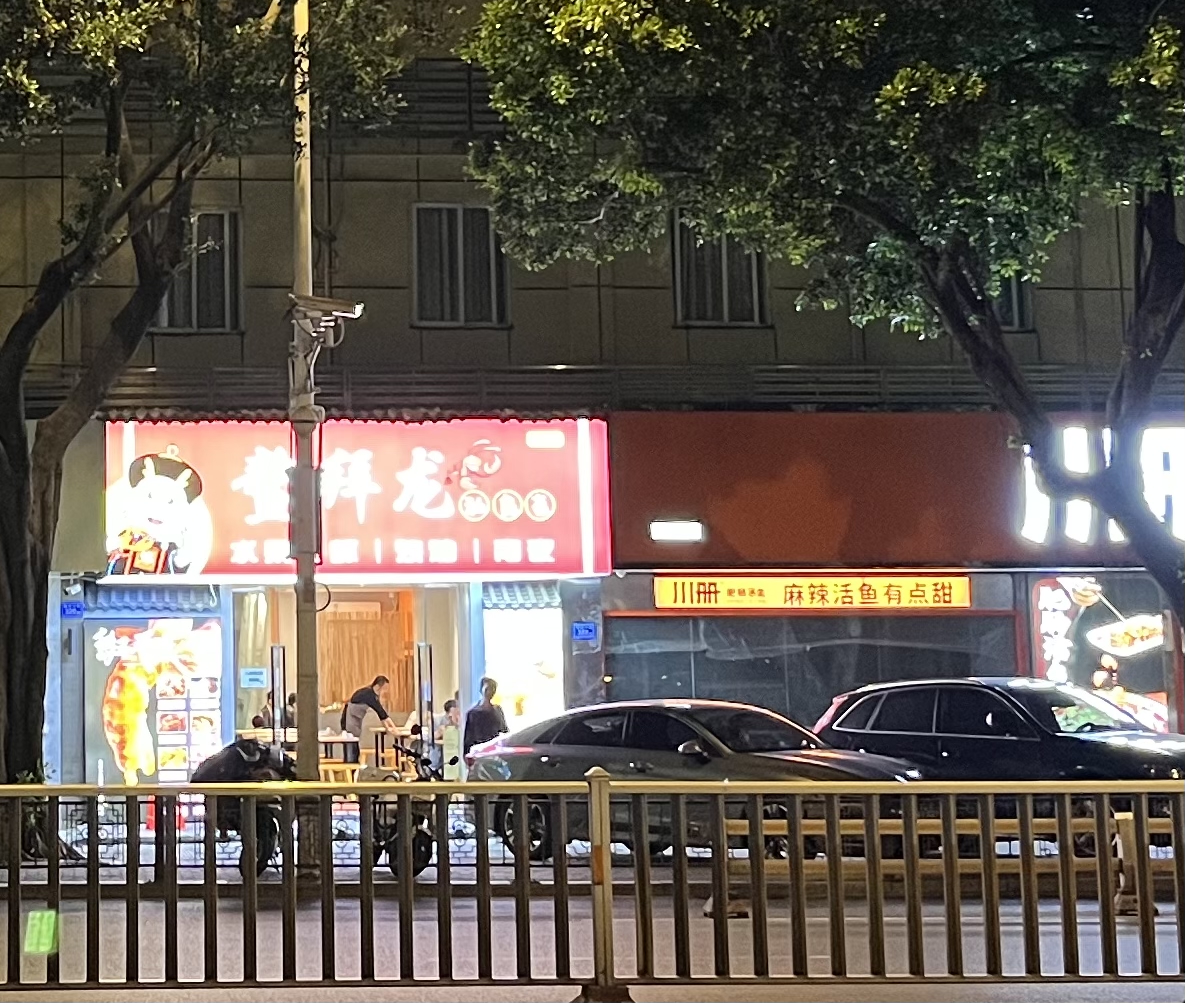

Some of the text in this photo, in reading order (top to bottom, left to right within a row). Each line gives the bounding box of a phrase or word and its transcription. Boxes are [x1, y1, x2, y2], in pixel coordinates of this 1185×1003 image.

[783, 582, 954, 606] 麻辣活鱼有点甜
